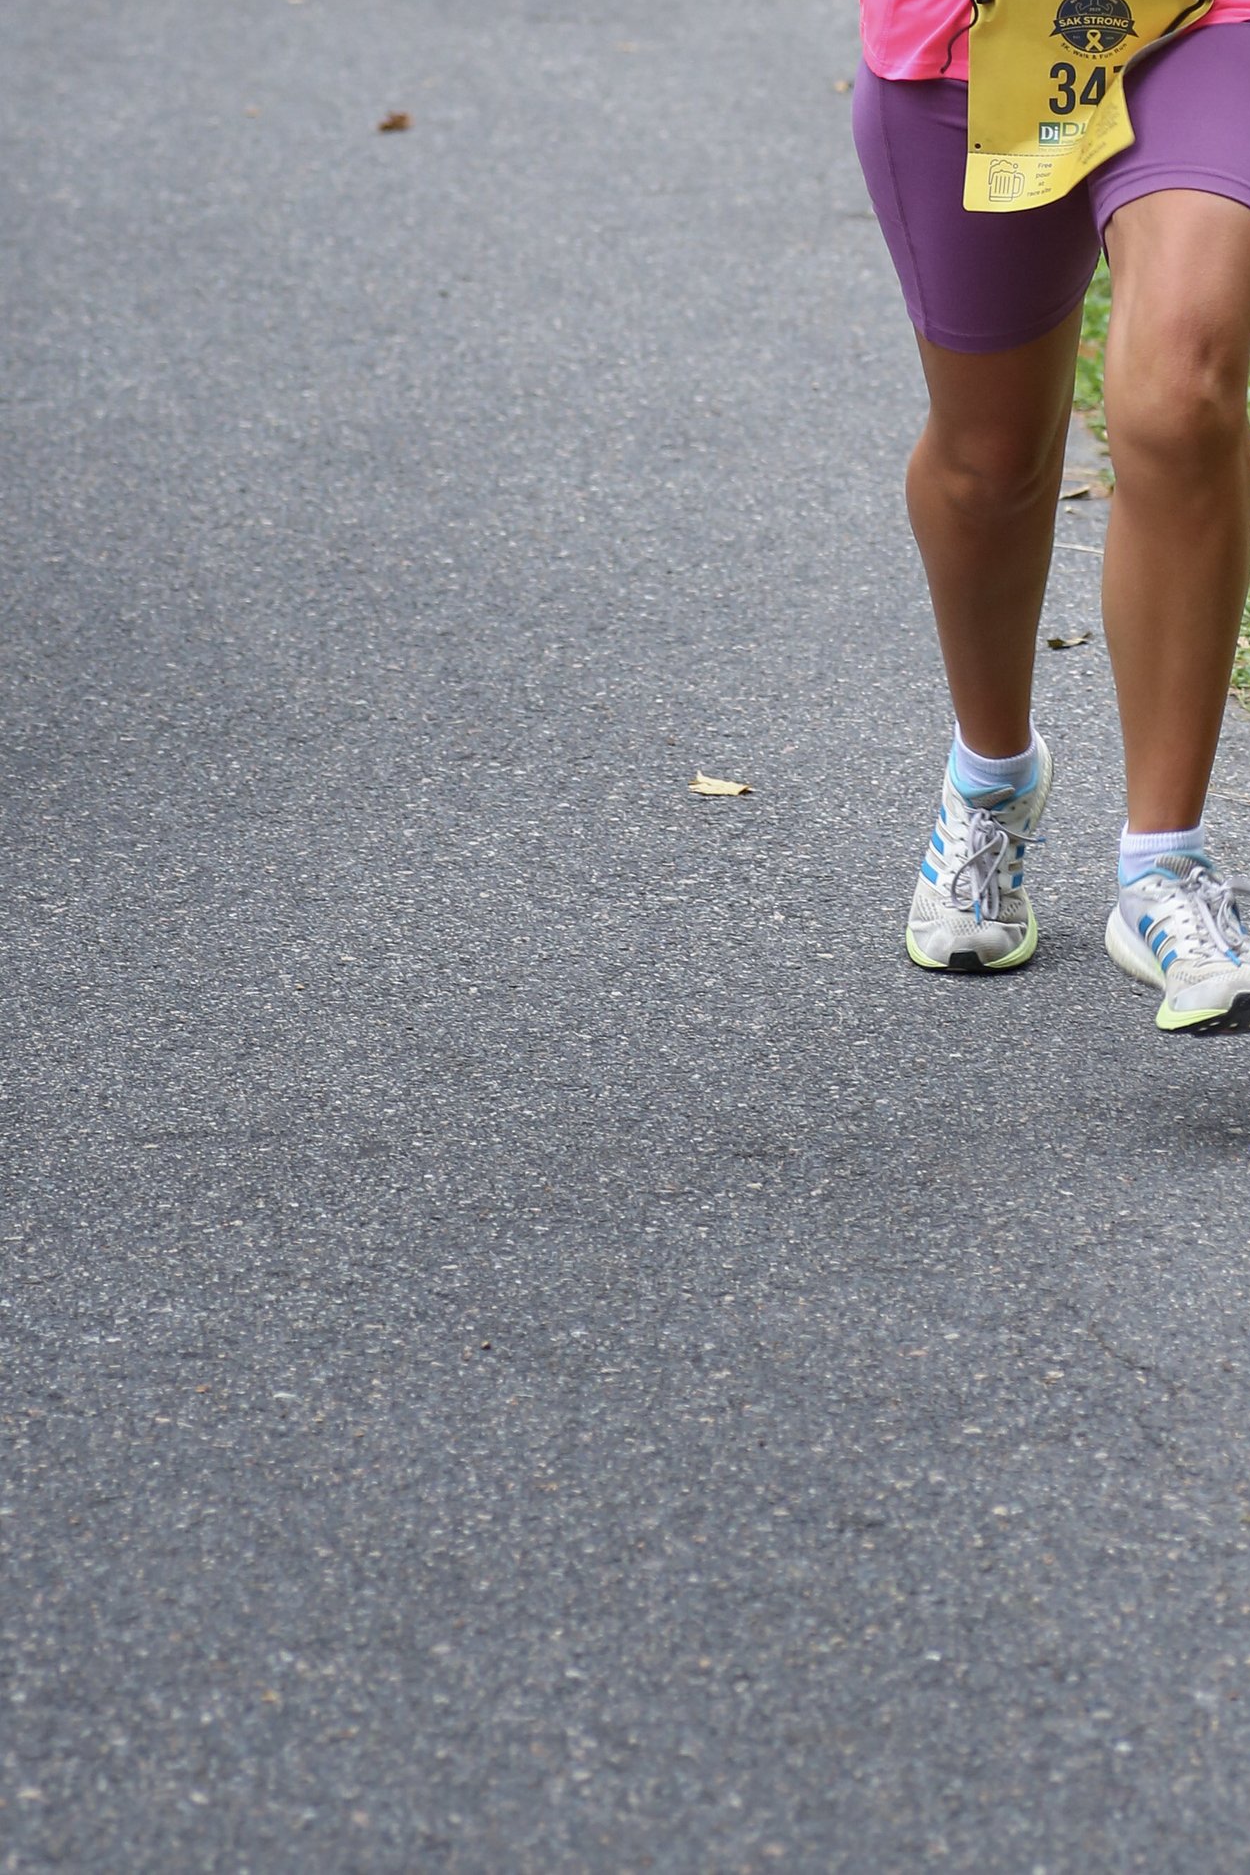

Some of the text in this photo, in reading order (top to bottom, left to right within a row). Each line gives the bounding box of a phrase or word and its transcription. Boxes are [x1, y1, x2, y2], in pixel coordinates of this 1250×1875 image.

[1059, 17, 1082, 28] SAK
[1083, 16, 1129, 28] STRONG
[1072, 50, 1089, 59] Walk
[1049, 62, 1124, 115] 34
